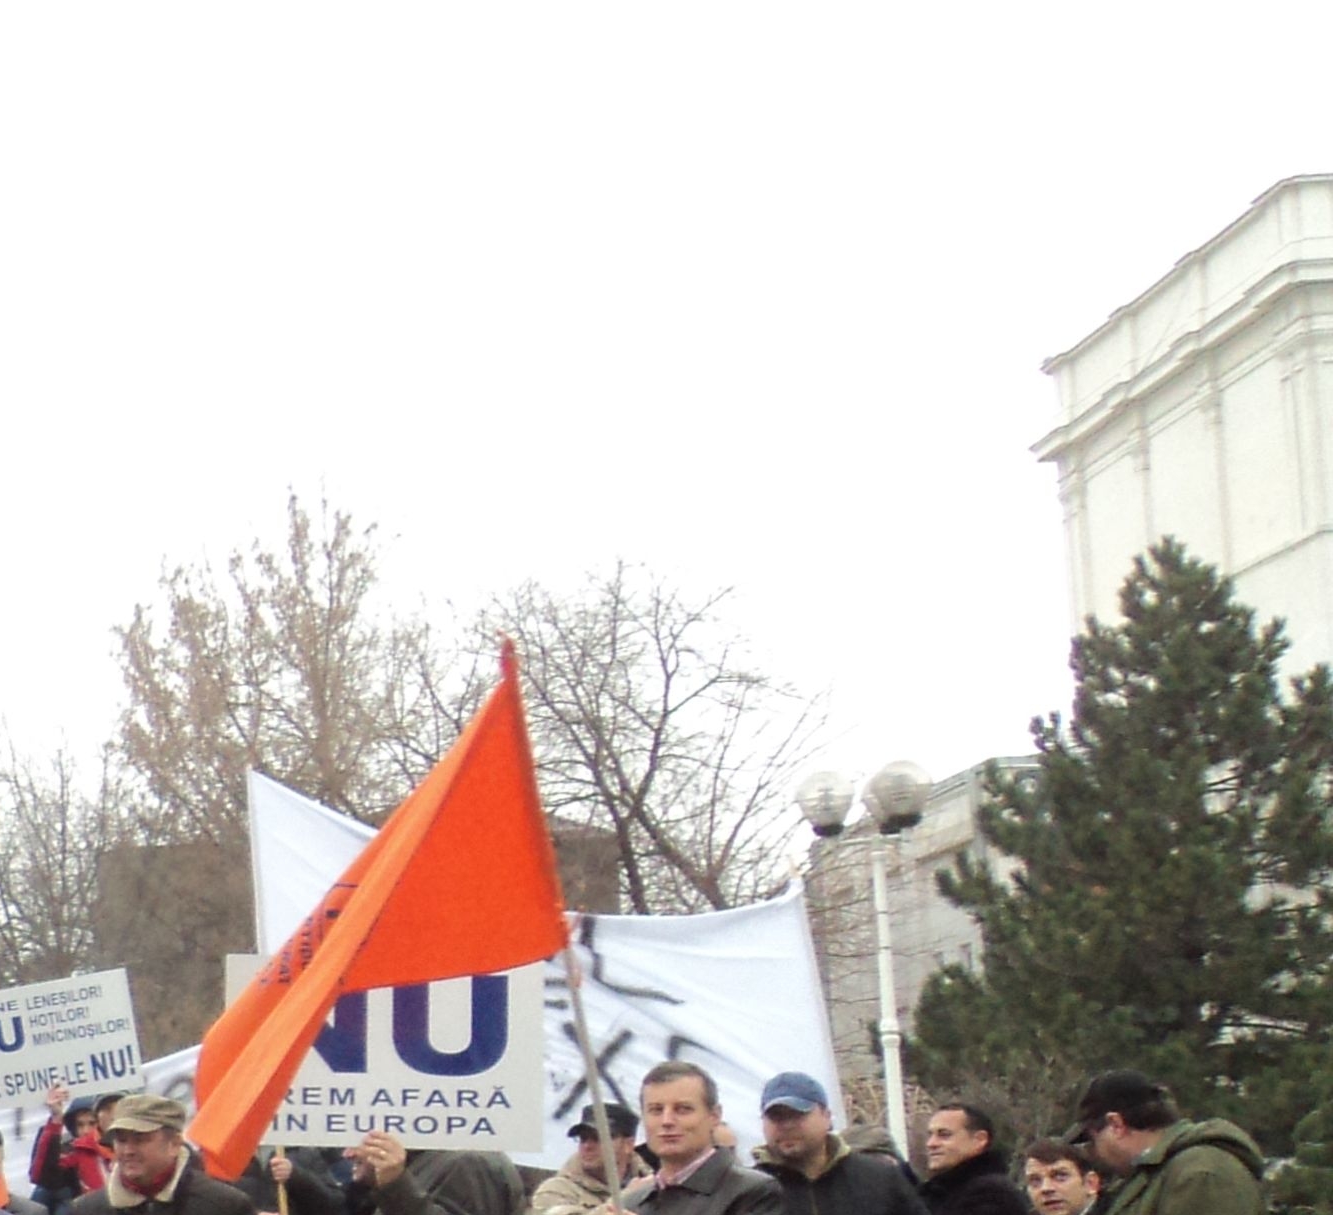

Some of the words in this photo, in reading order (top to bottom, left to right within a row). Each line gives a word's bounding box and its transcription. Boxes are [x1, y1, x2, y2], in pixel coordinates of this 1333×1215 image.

[4, 1062, 88, 1097] SPUNE-LE
[90, 1044, 136, 1081] NU!
[370, 1085, 512, 1110] AFARĂ
[272, 1113, 308, 1132] IN
[325, 1114, 497, 1136] EUROPA
